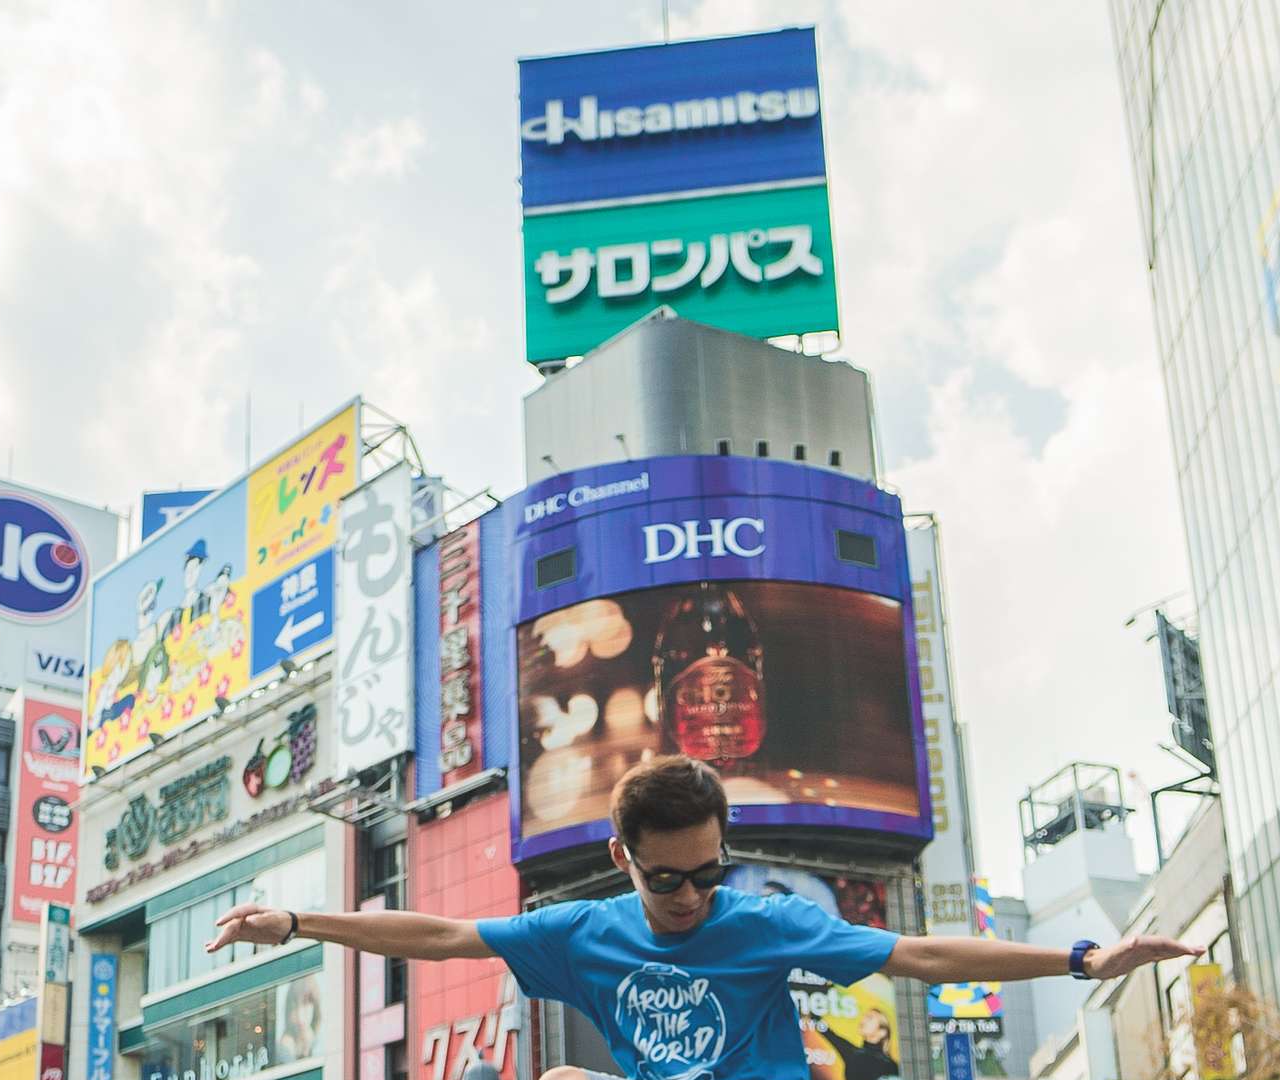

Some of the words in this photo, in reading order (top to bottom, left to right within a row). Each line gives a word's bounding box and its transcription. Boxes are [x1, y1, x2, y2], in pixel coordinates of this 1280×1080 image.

[521, 85, 820, 145] Hisamitsu
[534, 224, 824, 304] サロンパス
[524, 492, 567, 524] DHC
[568, 472, 650, 507] Channel
[643, 516, 766, 565] DHC
[339, 487, 407, 749] もんじゃ
[627, 978, 709, 1025] AROUND
[649, 1009, 693, 1042] THE
[790, 987, 859, 1019] nets
[633, 1017, 715, 1065] WORLD
